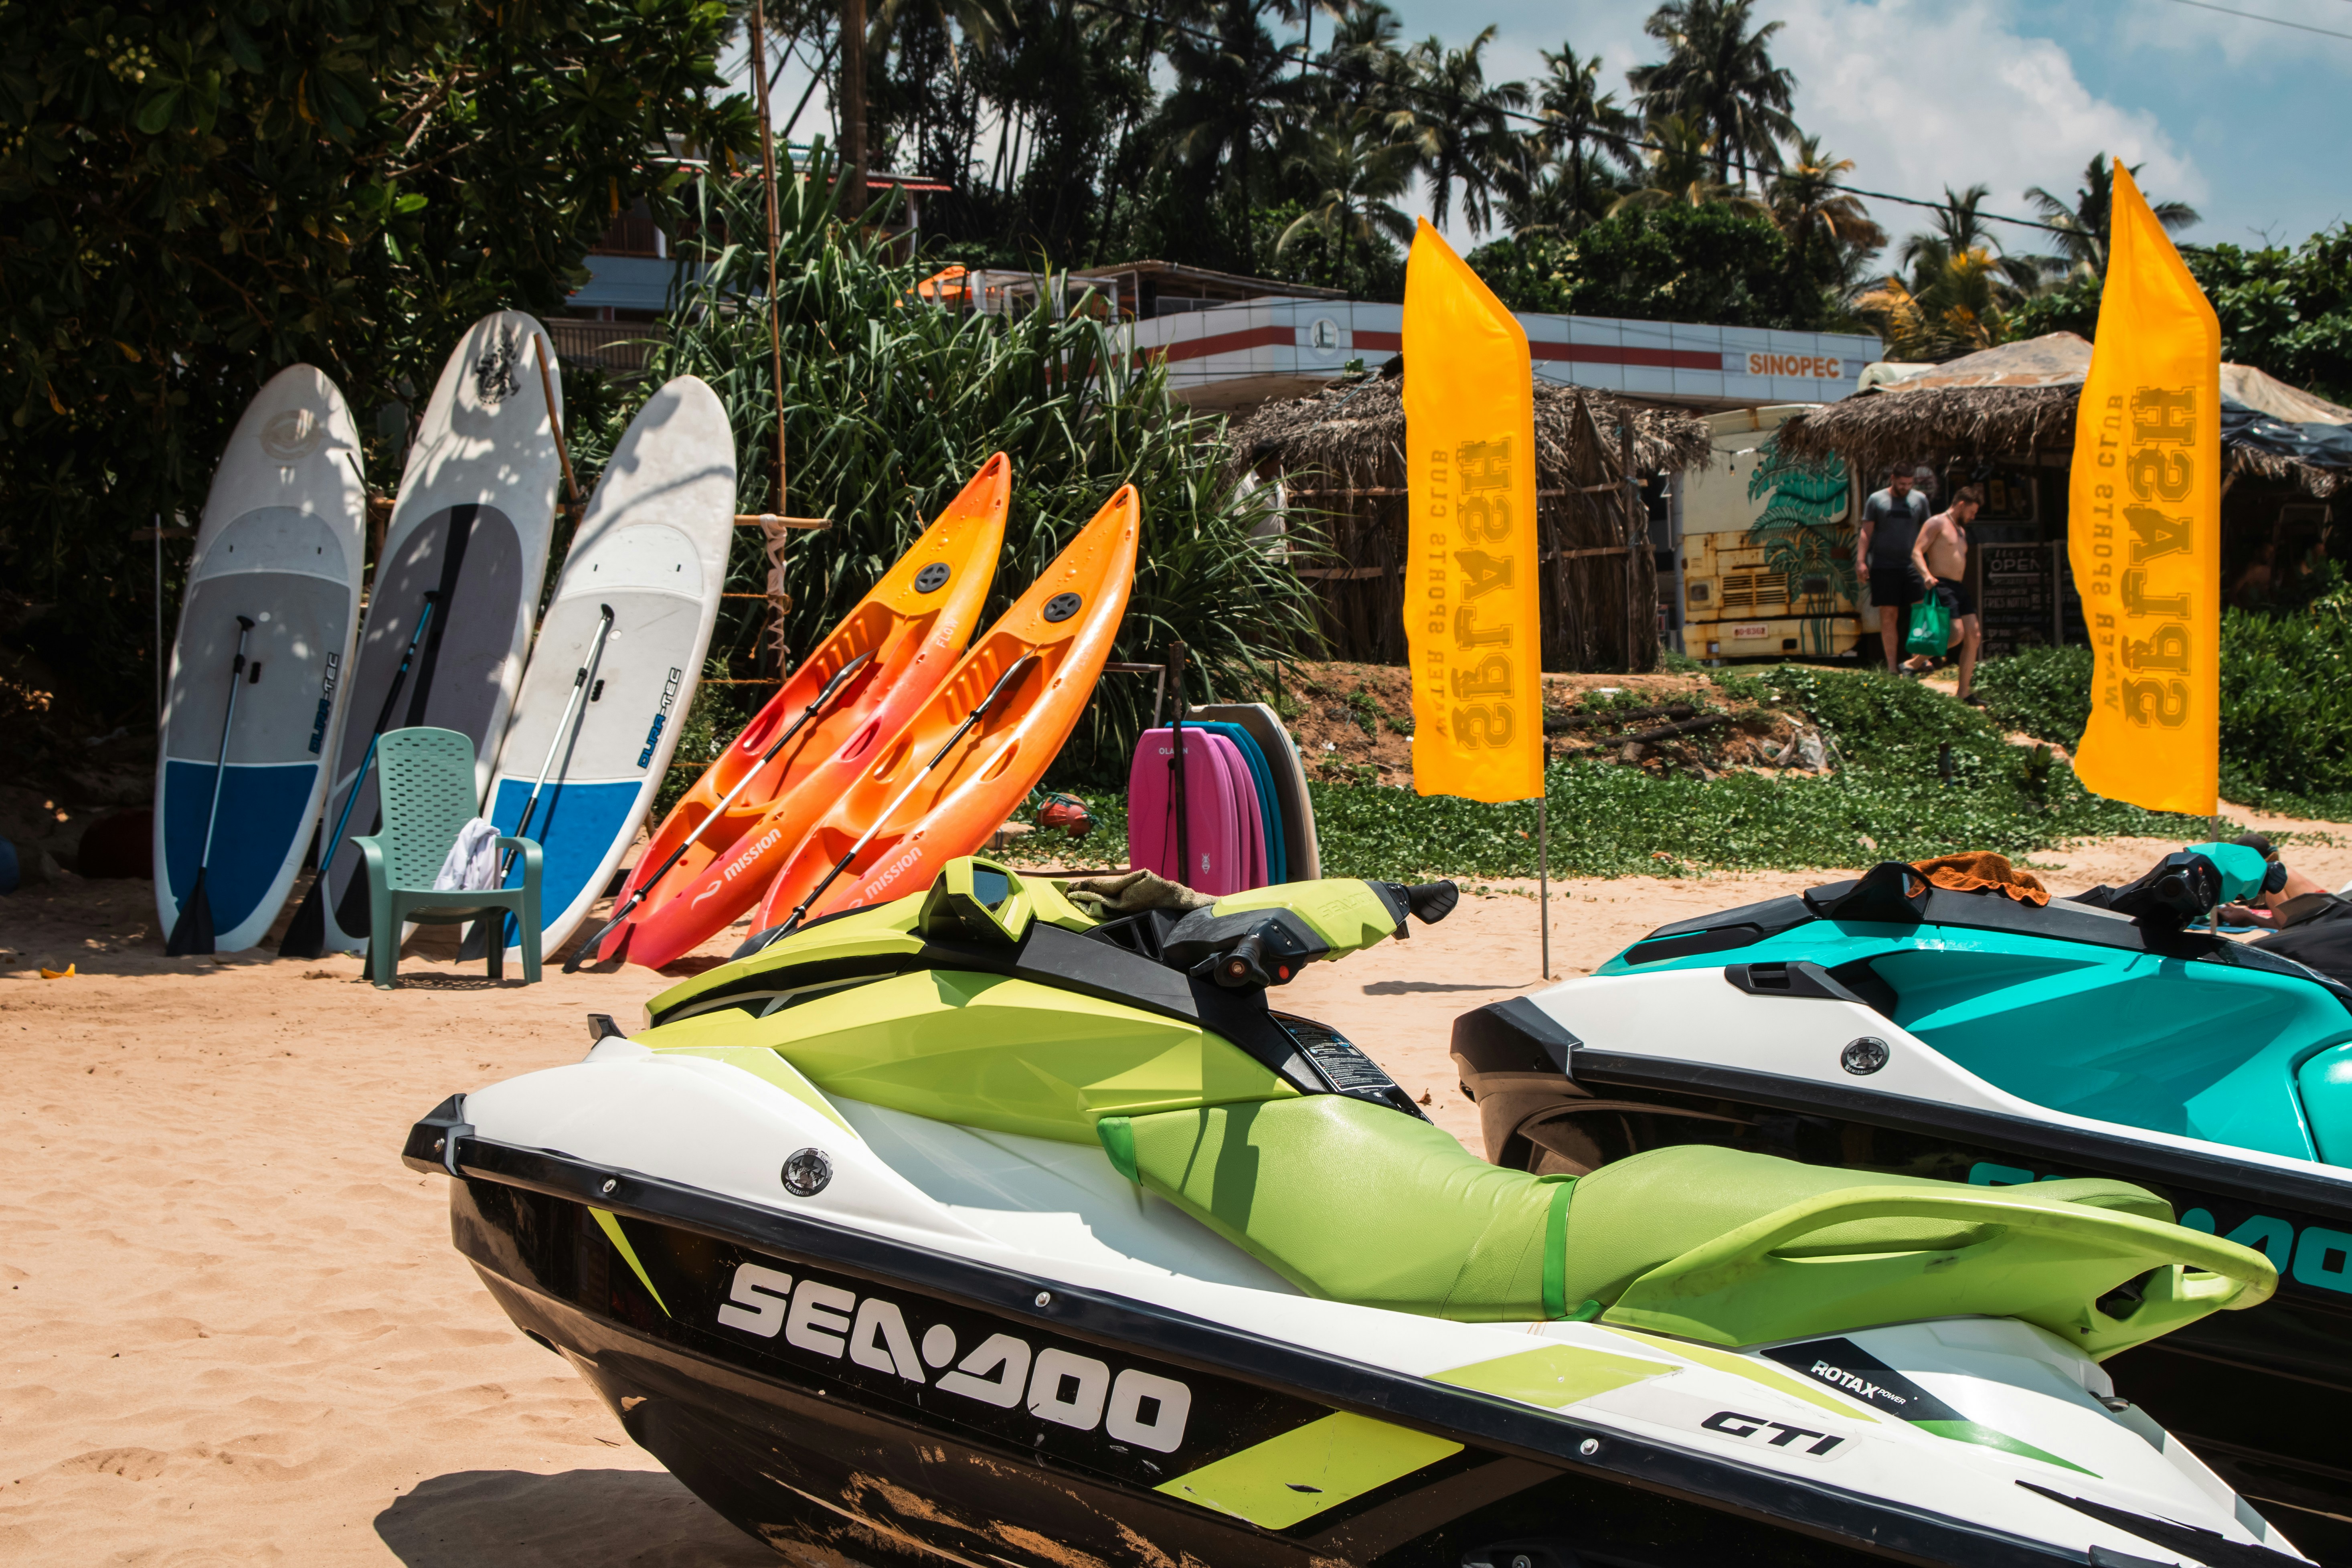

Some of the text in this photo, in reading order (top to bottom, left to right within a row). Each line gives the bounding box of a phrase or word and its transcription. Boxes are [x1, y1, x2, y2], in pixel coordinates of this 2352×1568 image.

[1749, 353, 1840, 378] SINOPEC
[936, 617, 958, 648] FLOW
[637, 667, 682, 769] DURA-TEC
[723, 828, 782, 882] mission
[864, 846, 923, 900] mission
[785, 1182, 810, 1195] EMISSION
[1810, 1360, 1907, 1405] ROTAX POWER
[1700, 1411, 1846, 1456] GTI
